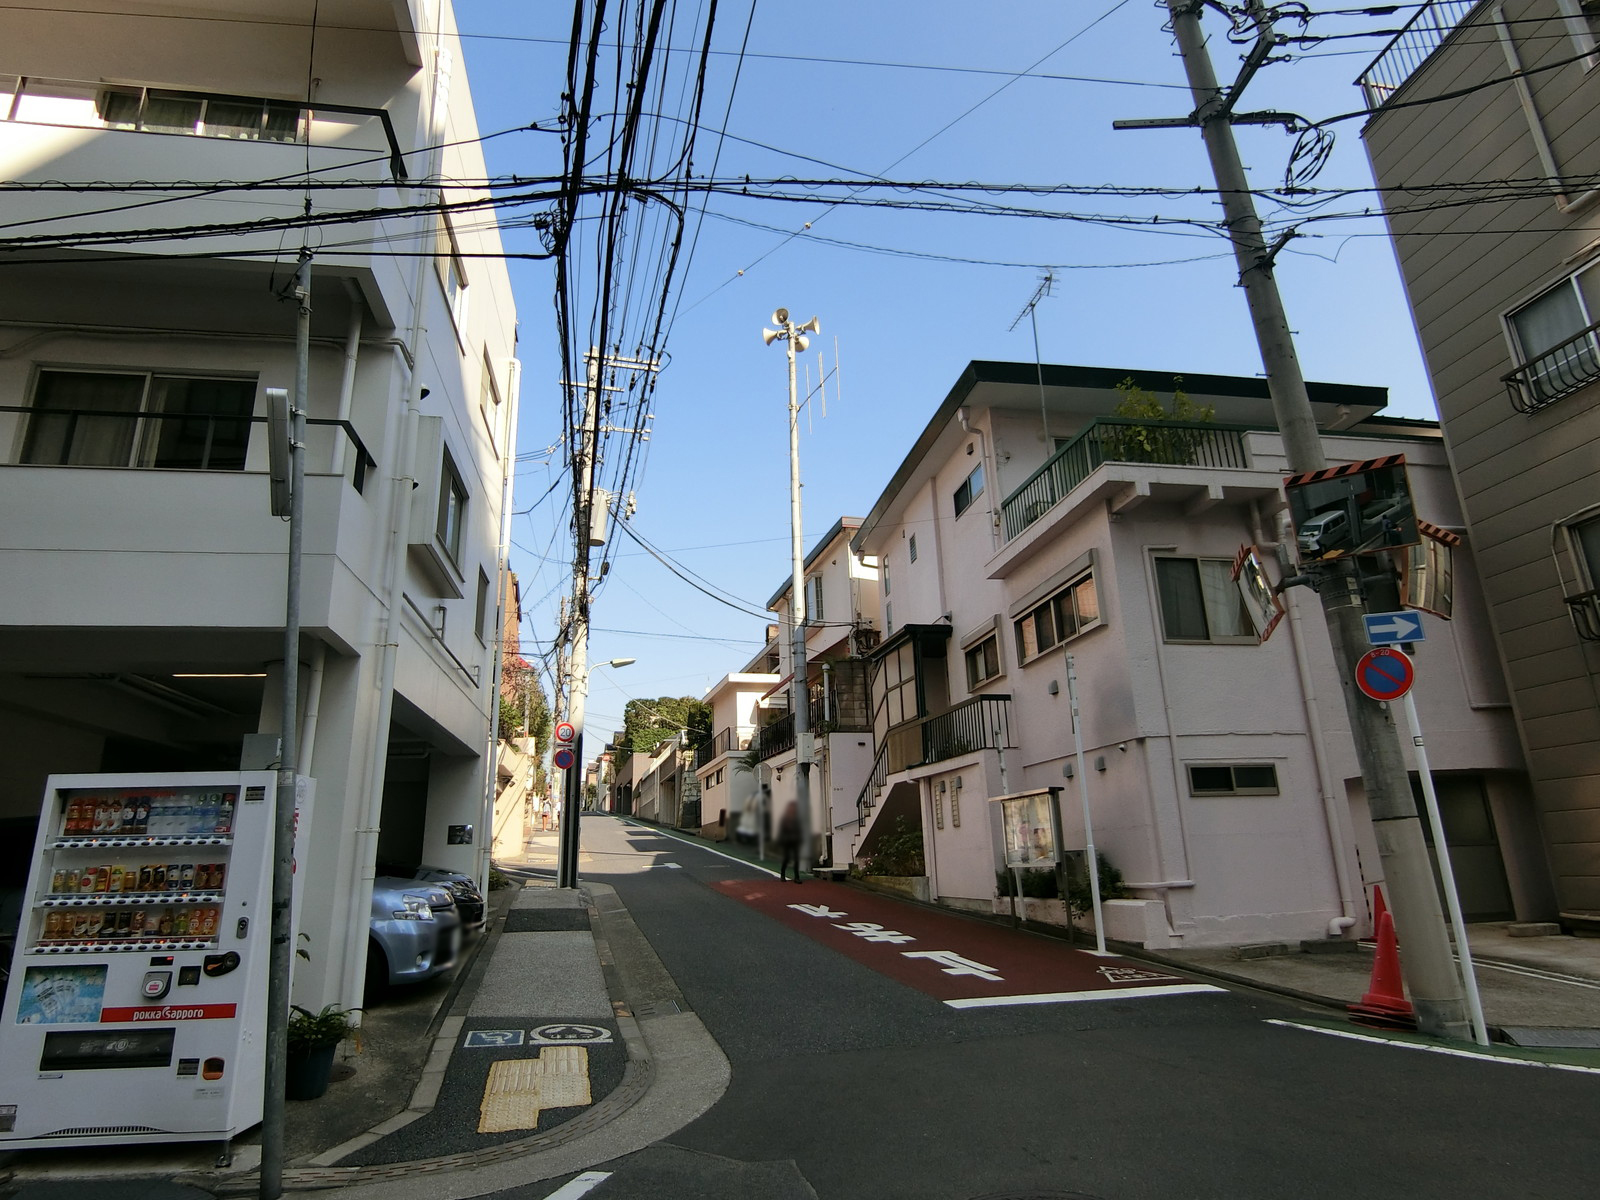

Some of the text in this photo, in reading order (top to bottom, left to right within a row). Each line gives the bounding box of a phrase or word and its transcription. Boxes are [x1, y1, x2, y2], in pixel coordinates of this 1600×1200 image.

[560, 728, 571, 737] 20
[786, 903, 1005, 982] 止まれ
